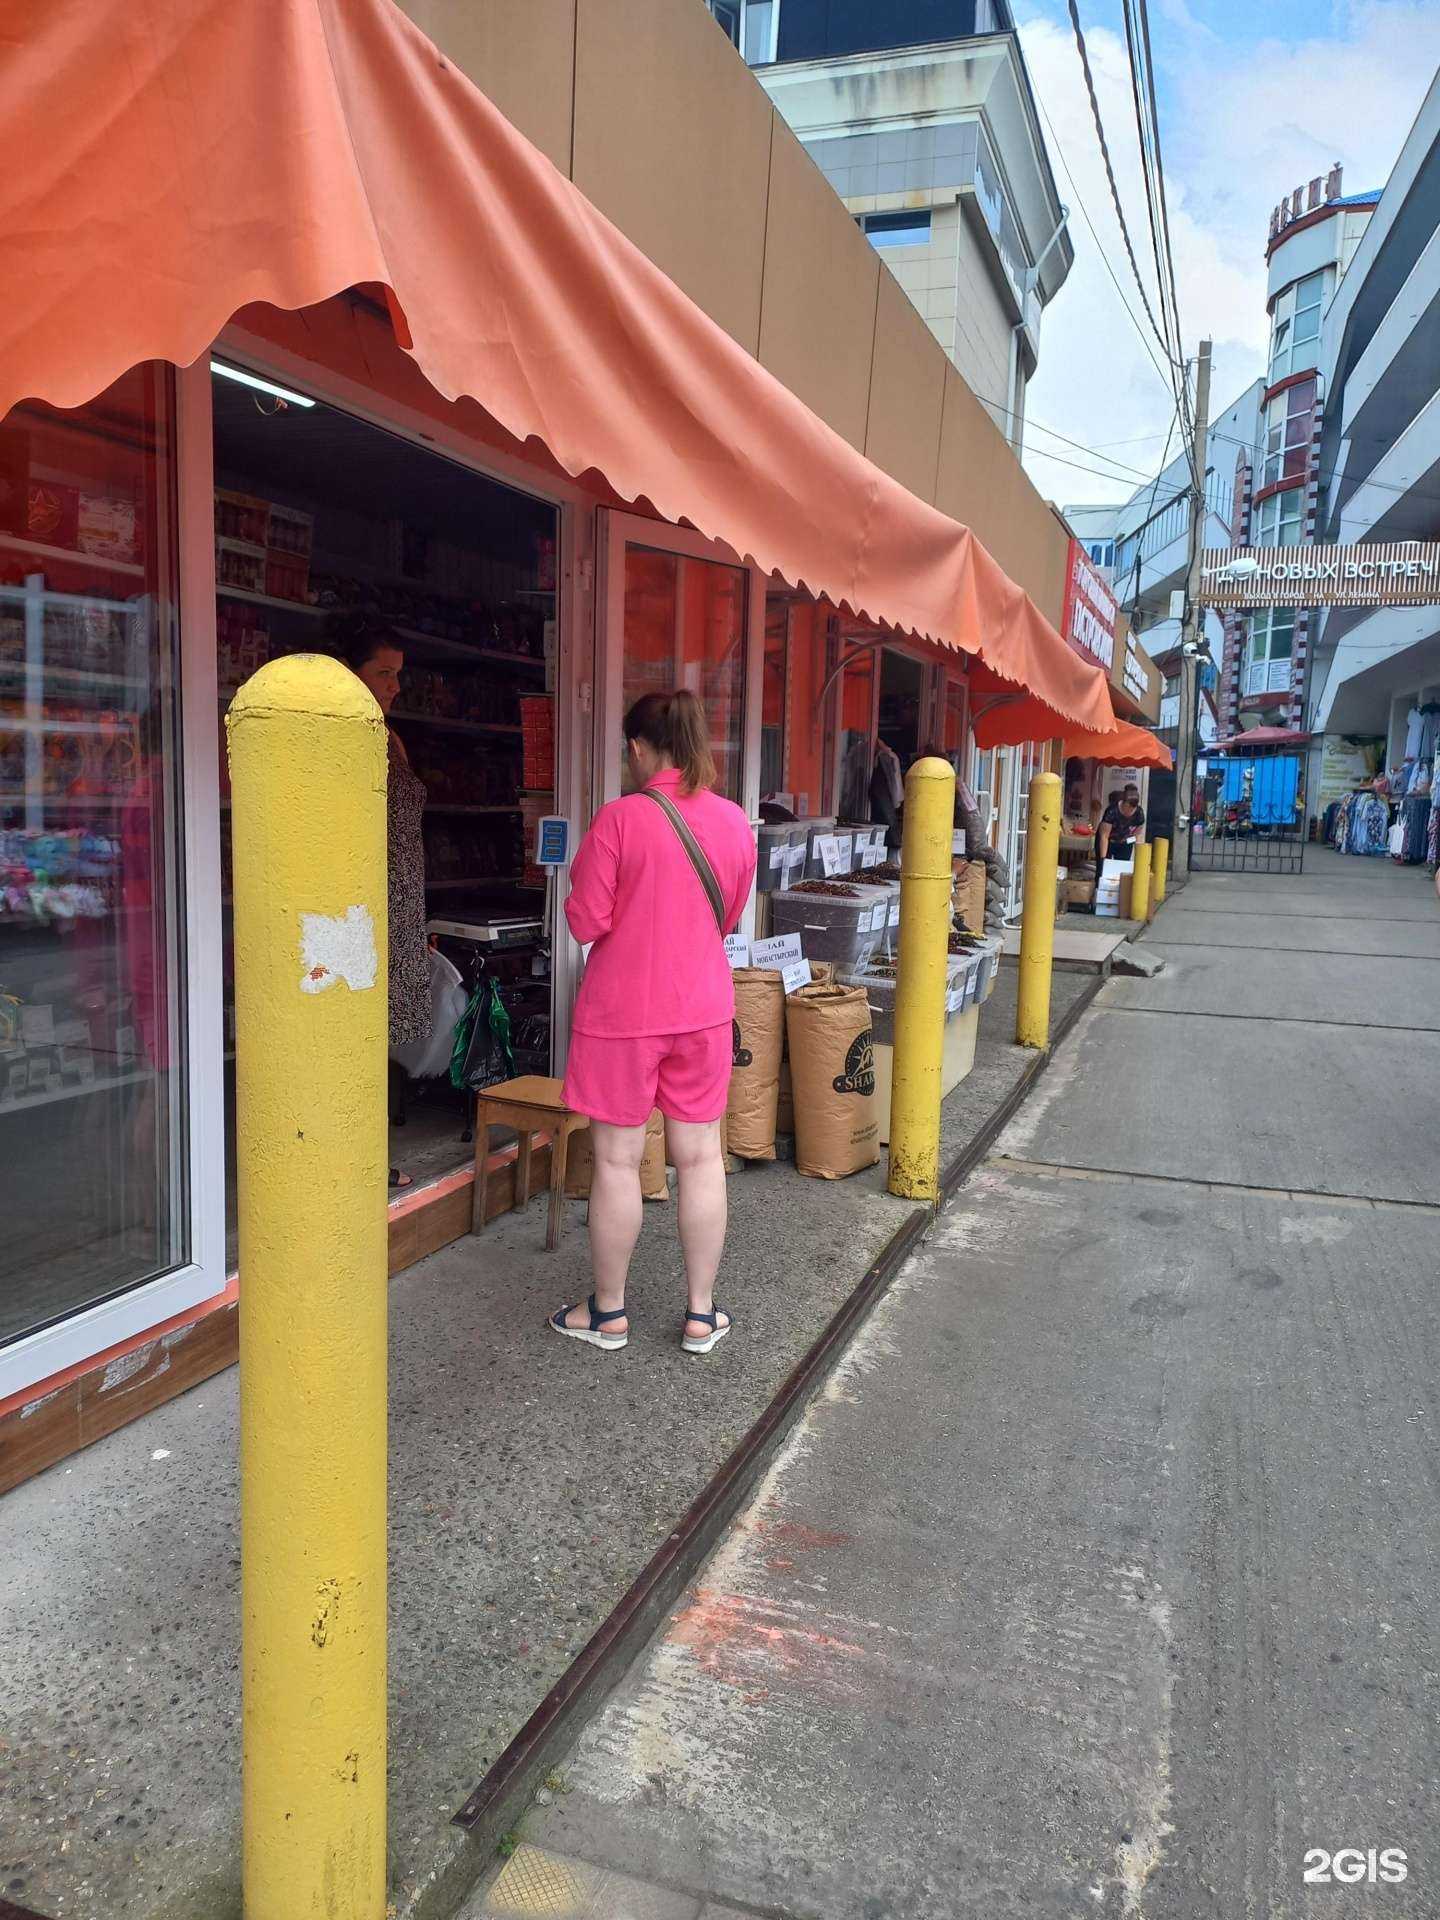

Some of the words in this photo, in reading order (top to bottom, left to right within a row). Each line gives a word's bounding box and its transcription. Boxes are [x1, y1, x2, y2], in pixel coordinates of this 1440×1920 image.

[1256, 562, 1339, 580] НОВЫХ
[1280, 592, 1305, 600] ГОРОД
[1313, 592, 1324, 600] НА
